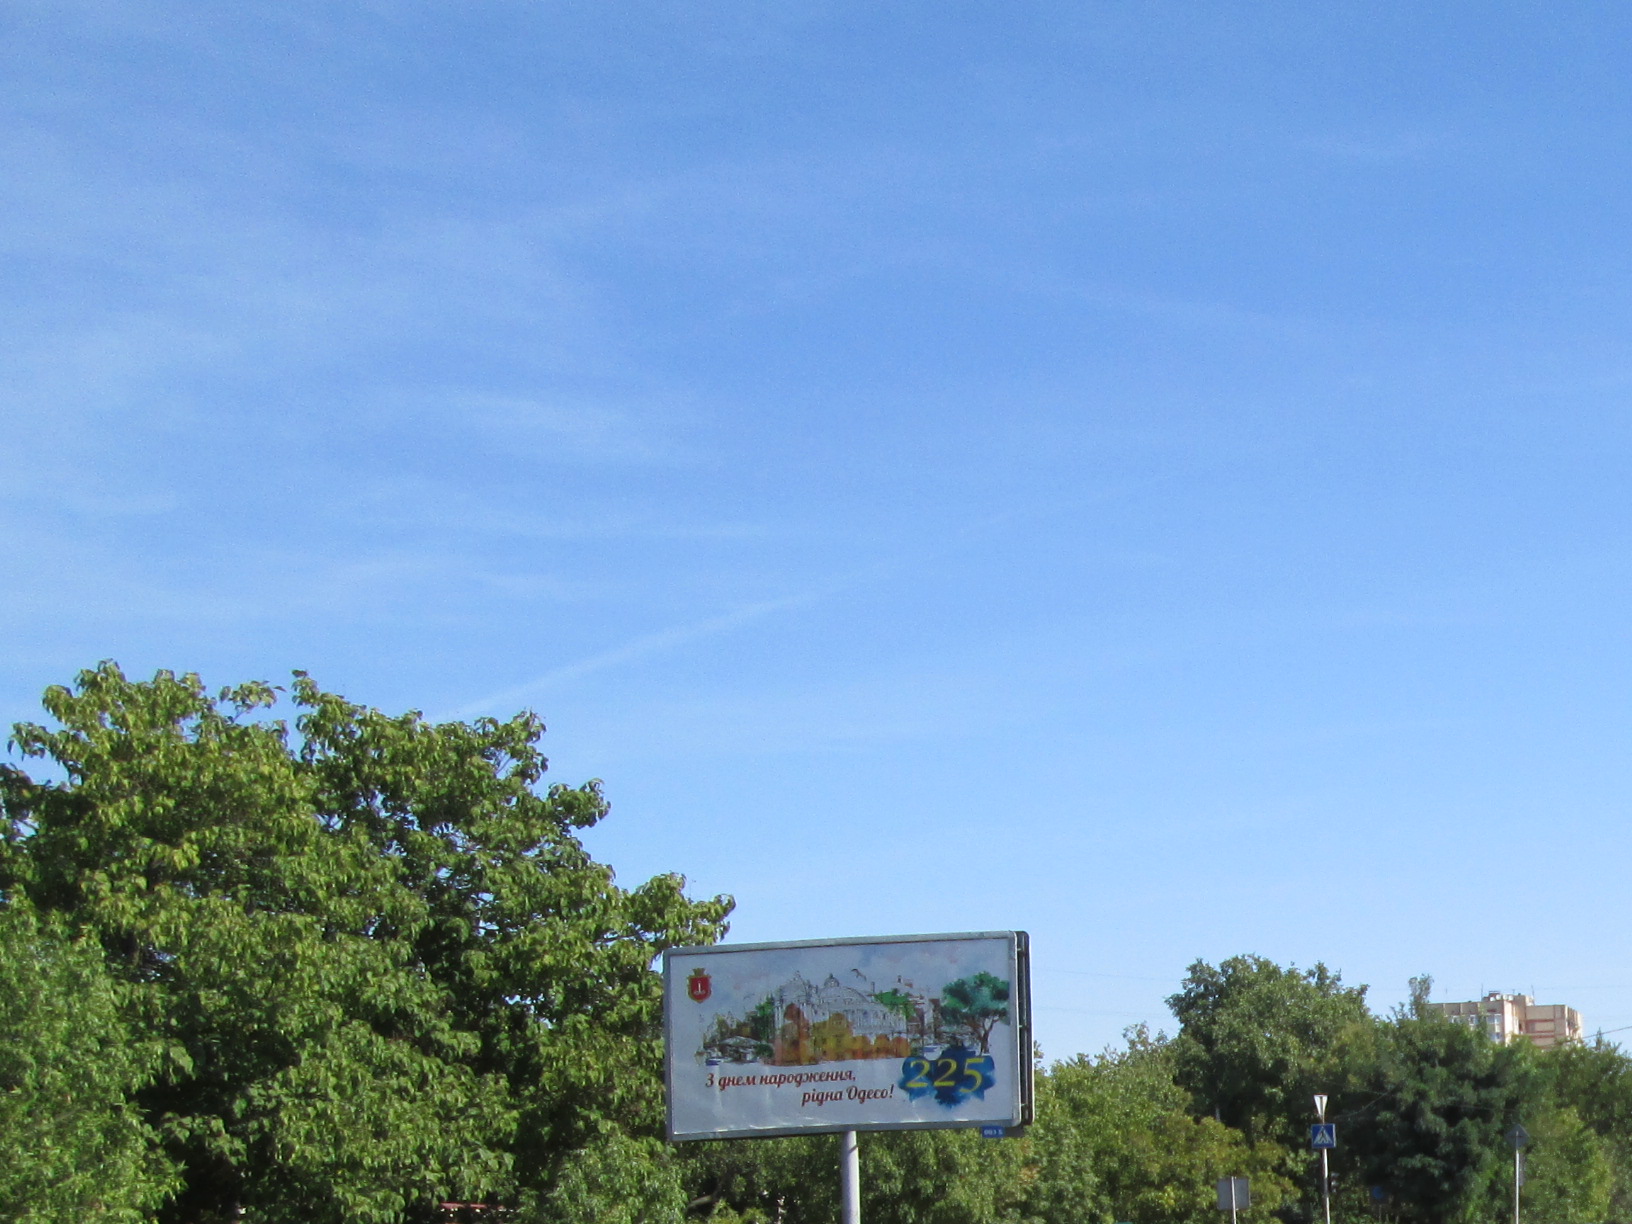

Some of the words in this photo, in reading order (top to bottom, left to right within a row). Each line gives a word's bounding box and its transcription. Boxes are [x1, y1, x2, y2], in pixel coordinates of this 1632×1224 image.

[705, 1073, 714, 1088] З
[718, 1075, 756, 1092] днем
[759, 1070, 856, 1089] народження,
[906, 1057, 985, 1093] 225
[801, 1088, 843, 1107] рідна
[846, 1084, 894, 1104] Одесо!
